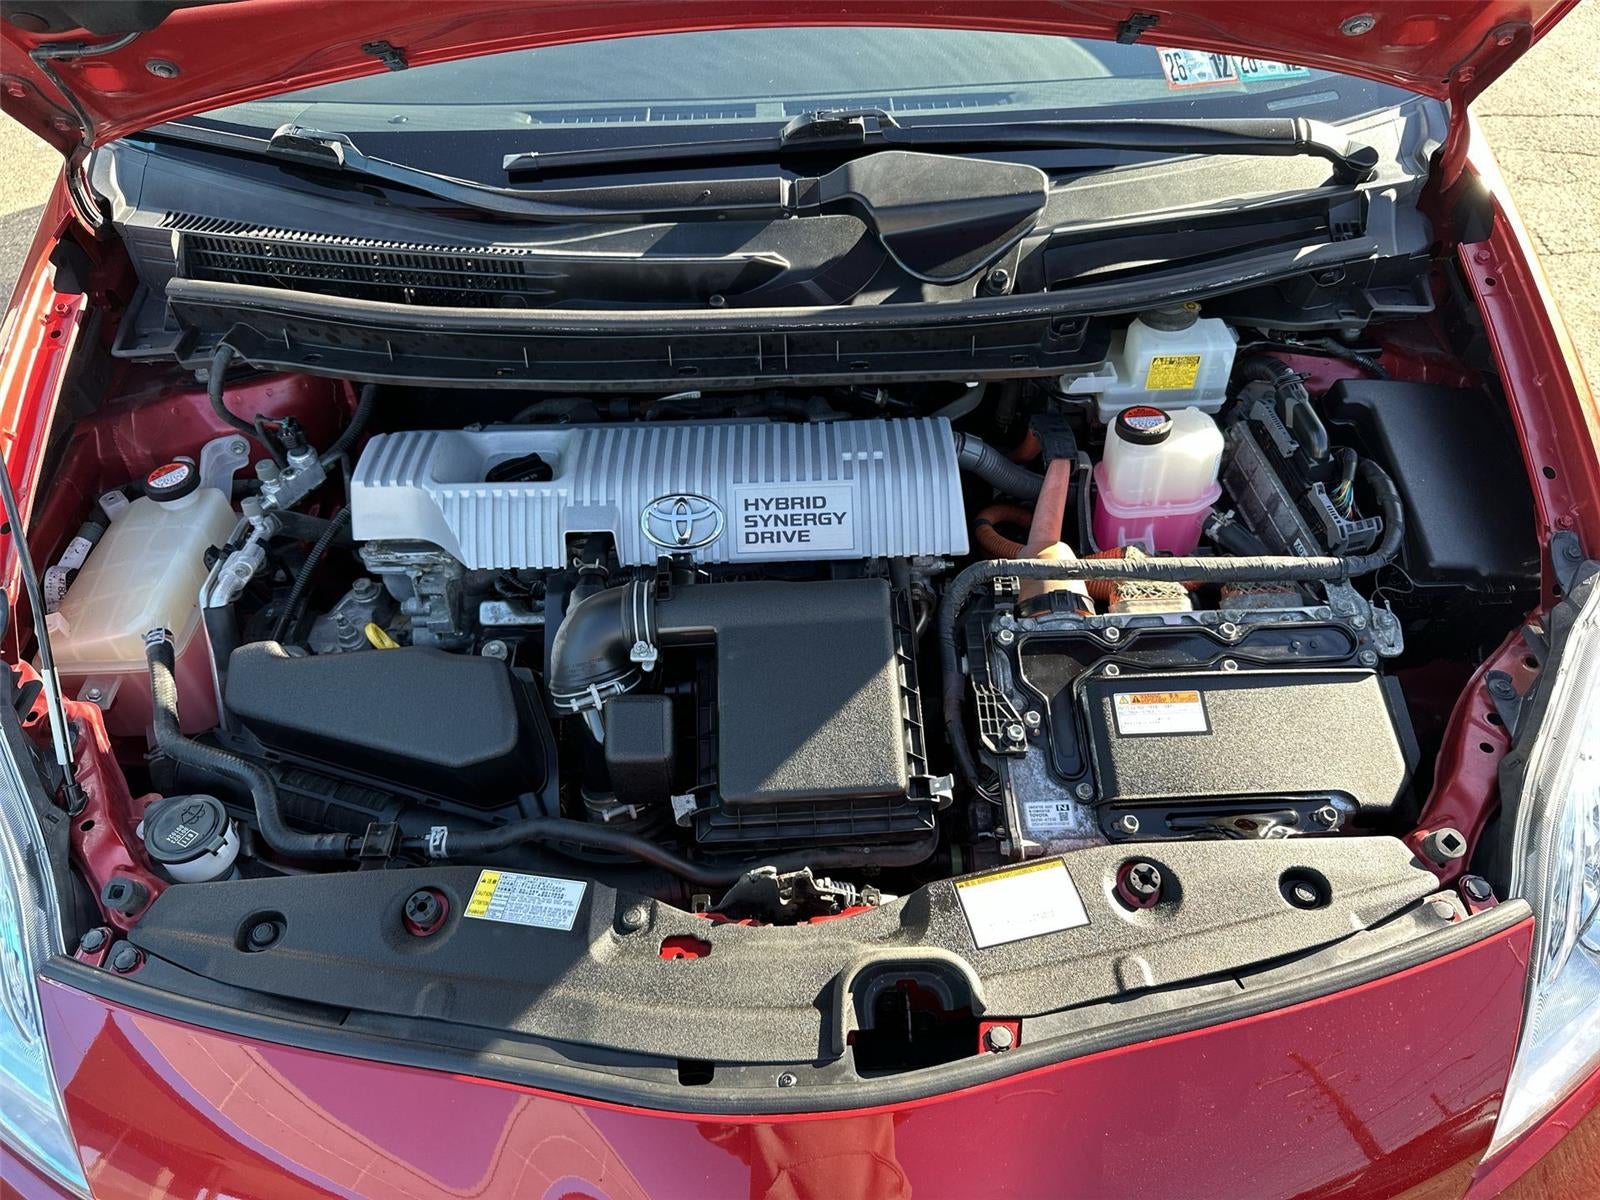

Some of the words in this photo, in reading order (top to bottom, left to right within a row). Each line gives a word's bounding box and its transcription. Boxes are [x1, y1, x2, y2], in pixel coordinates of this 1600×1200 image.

[1165, 52, 1188, 82] 26
[744, 496, 826, 511] HYBRID
[744, 512, 847, 529] SYNERGY
[745, 530, 811, 544] DRIVE
